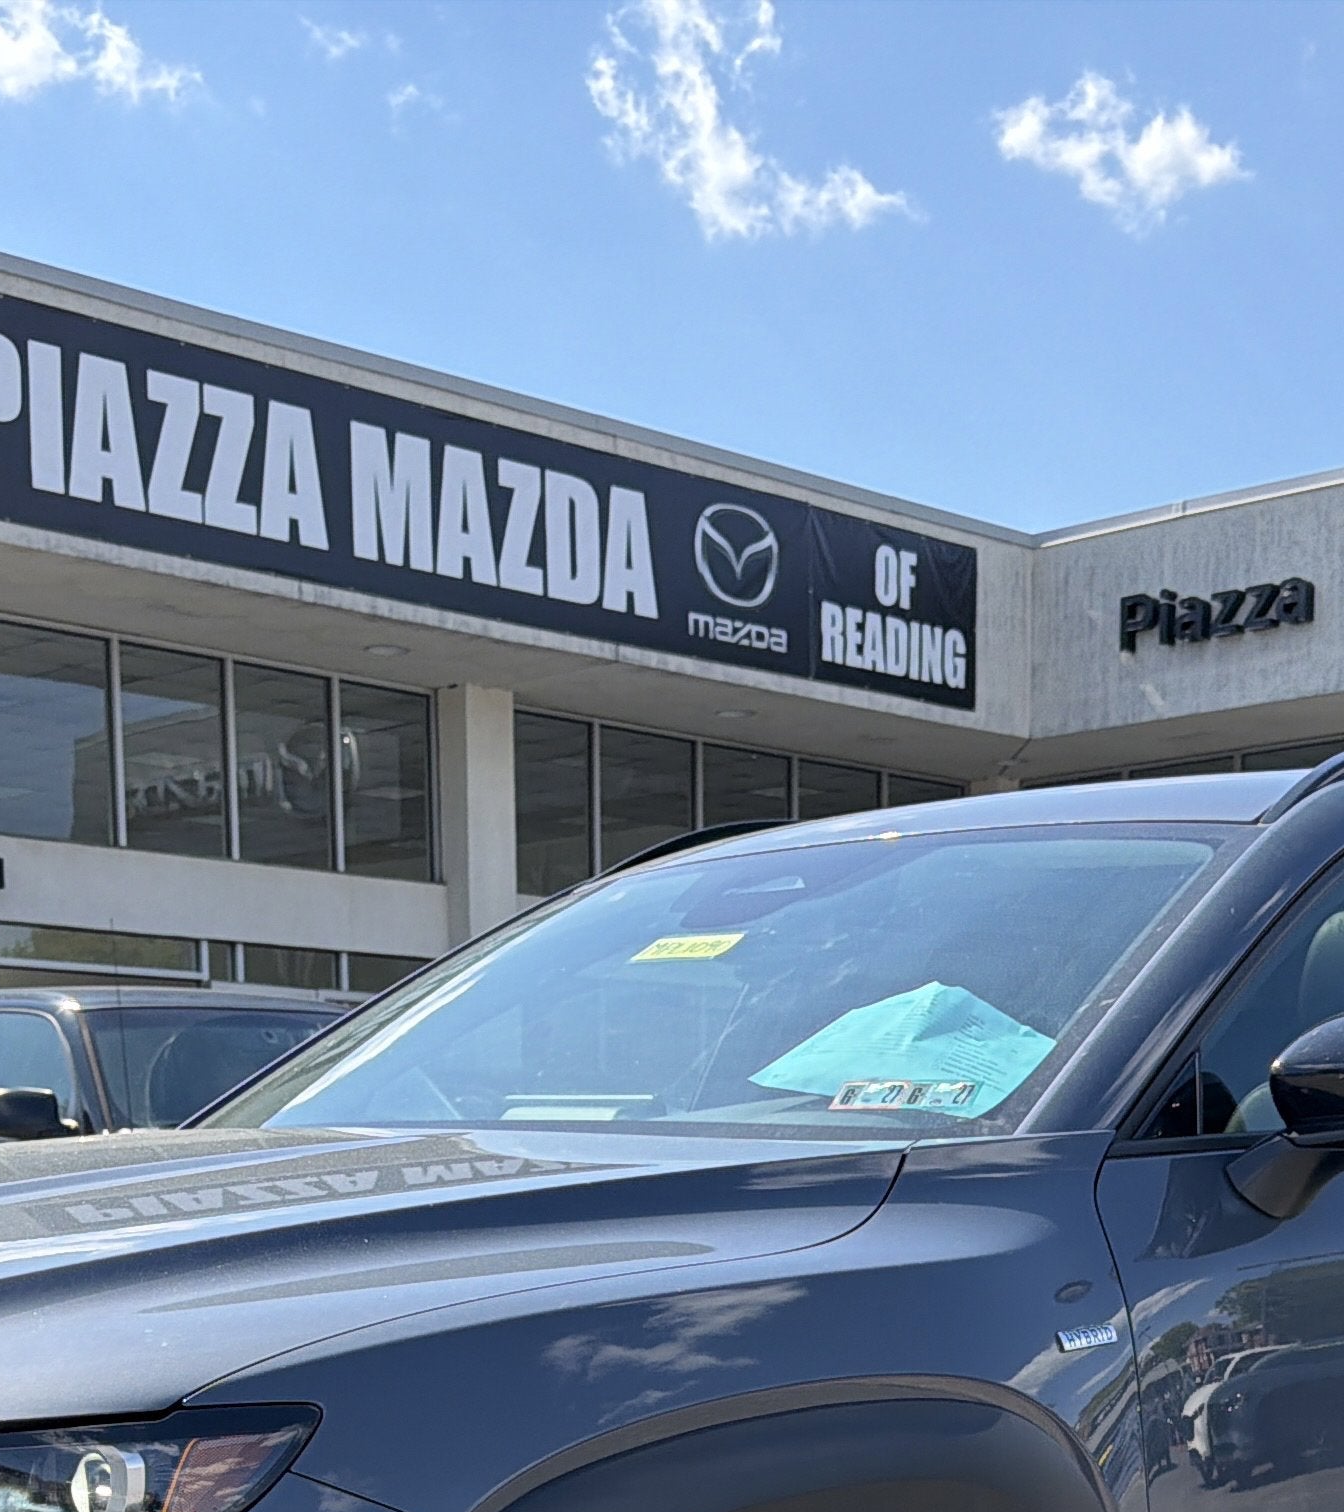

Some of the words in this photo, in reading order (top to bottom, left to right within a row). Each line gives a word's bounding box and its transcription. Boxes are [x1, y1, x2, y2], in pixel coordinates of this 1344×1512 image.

[350, 420, 659, 620] MAZDA
[874, 545, 918, 612] OF
[688, 612, 788, 653] mazda
[821, 601, 967, 689] READING
[1119, 576, 1316, 655] Piazza
[1064, 1326, 1113, 1348] HYBRID
